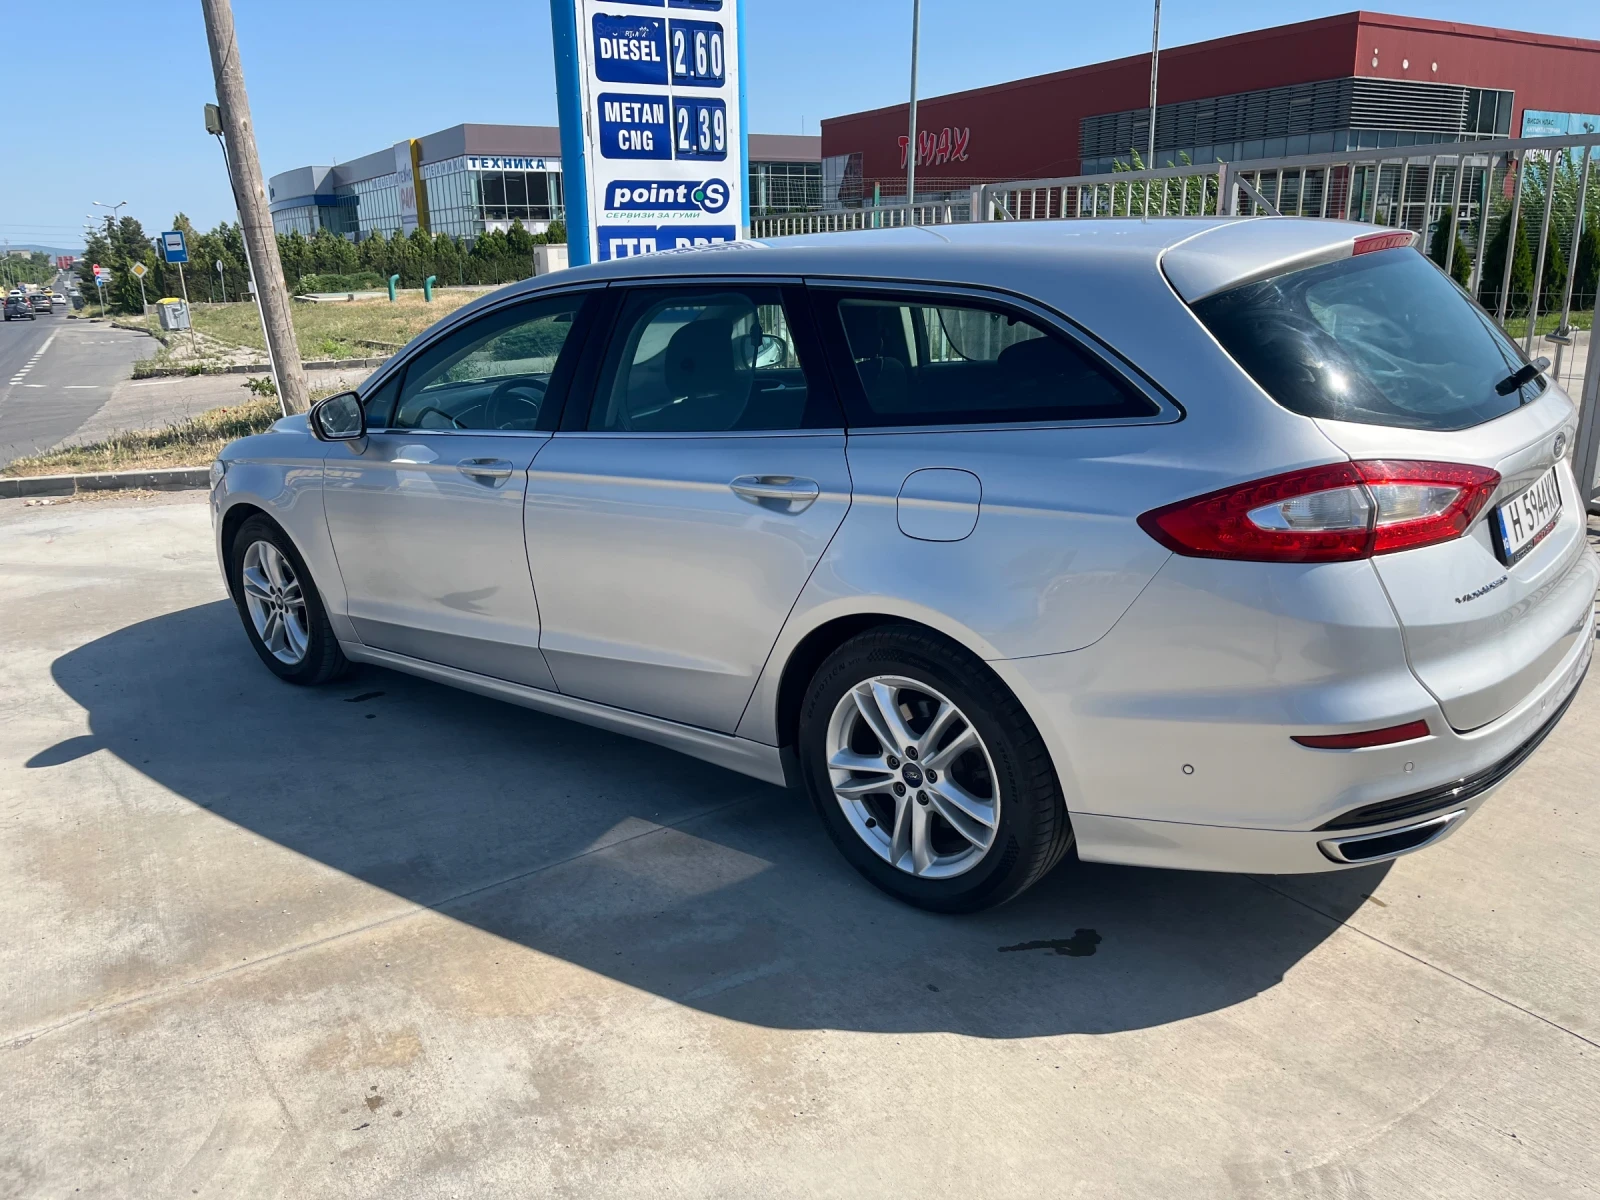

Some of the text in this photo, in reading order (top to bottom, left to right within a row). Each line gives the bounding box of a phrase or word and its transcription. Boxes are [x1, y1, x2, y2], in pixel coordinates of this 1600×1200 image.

[600, 38, 661, 62] DIESEL
[673, 30, 722, 77] 2.60
[604, 101, 664, 124] METAN
[618, 129, 654, 151] CNG
[678, 107, 725, 150] 2.39
[468, 156, 546, 170] ТЕХНИКА
[613, 183, 688, 208] point
